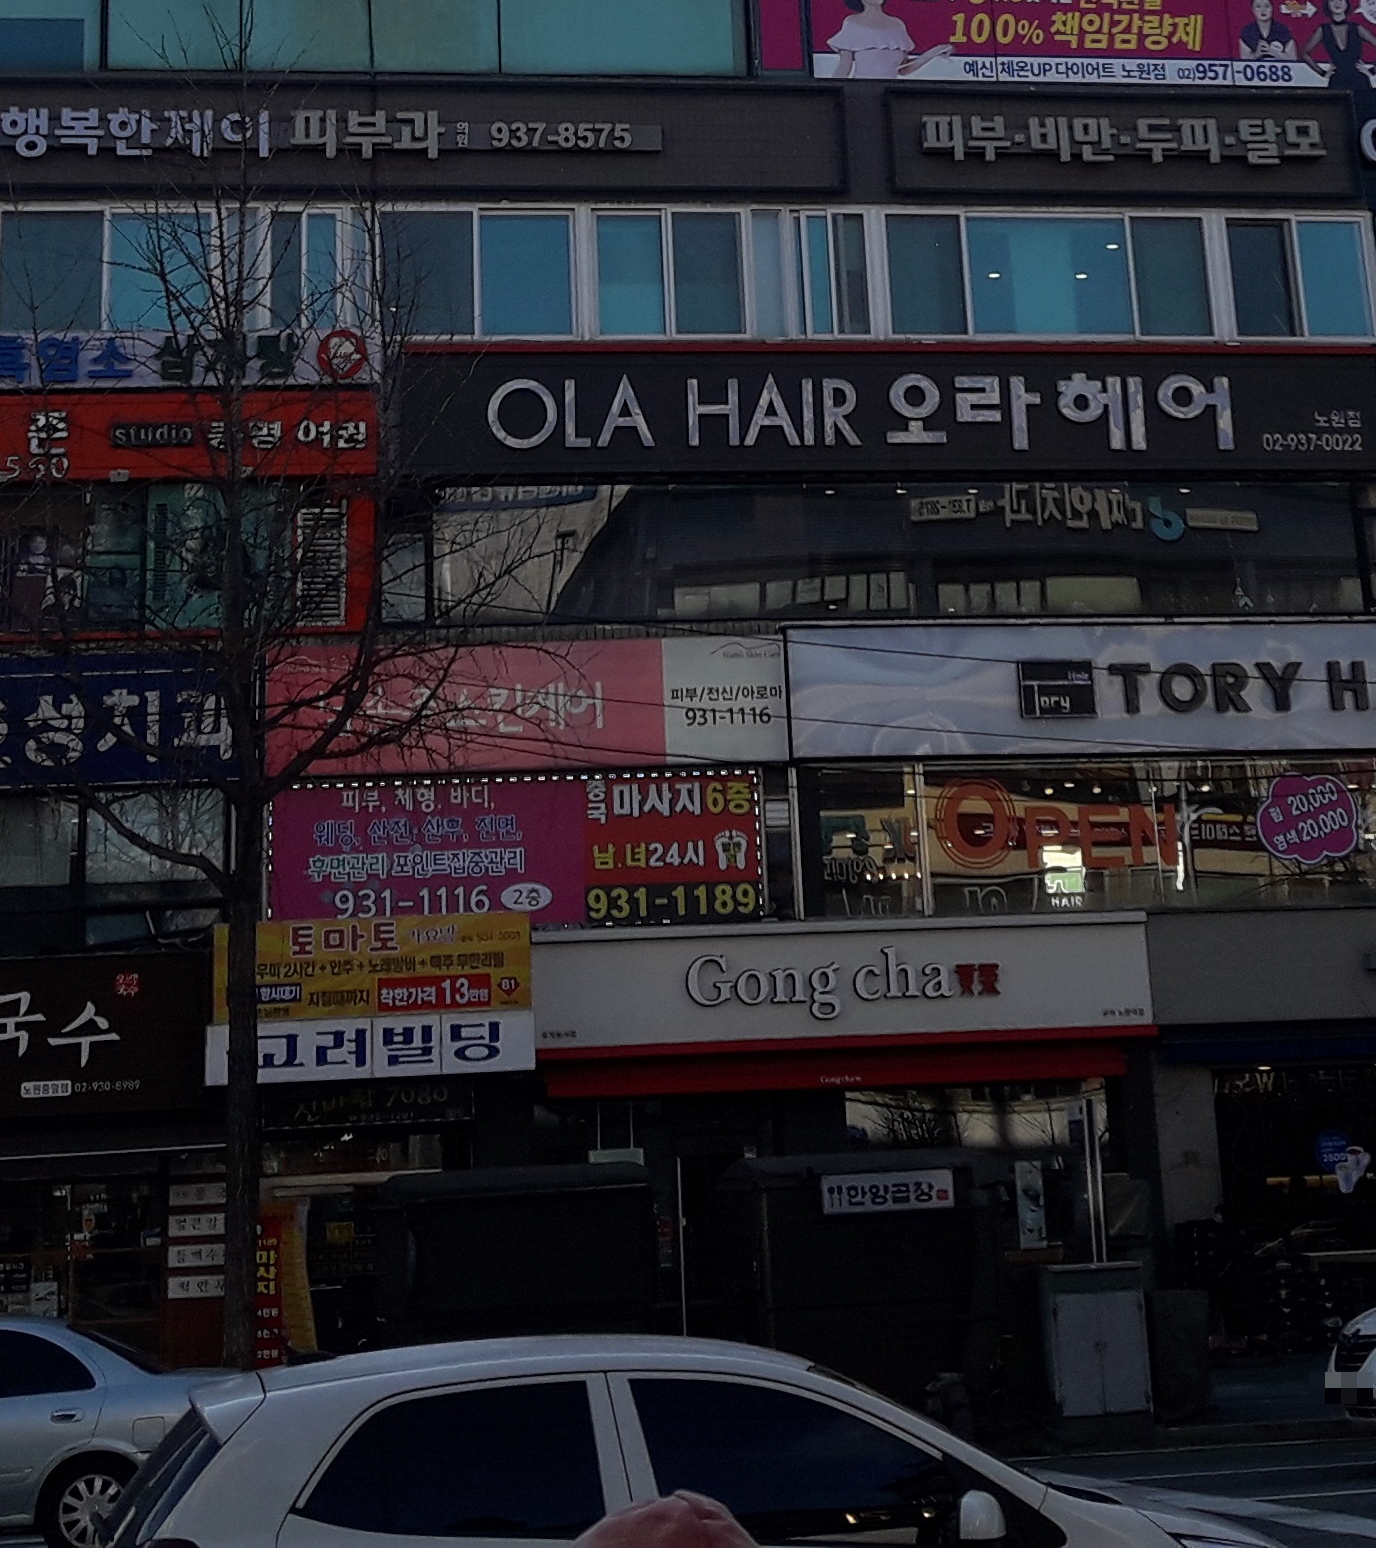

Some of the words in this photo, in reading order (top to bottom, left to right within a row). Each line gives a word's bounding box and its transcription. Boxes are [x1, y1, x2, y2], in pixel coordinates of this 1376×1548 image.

[948, 12, 1046, 48] 100%
[1049, 12, 1205, 53] 책임감량제
[963, 60, 996, 81] 예신
[1055, 60, 1117, 81] 다이어트
[1120, 62, 1168, 83] 노원점
[290, 107, 446, 162] 피부과
[490, 119, 634, 151] 937-8575
[486, 372, 657, 451] OLA
[685, 372, 862, 449] HAIR
[885, 370, 1235, 453] 오라헤어
[1312, 408, 1362, 431] 노원점
[296, 418, 369, 451] 여권
[1261, 431, 1363, 453] 02-937-0022
[1107, 660, 1305, 714] TORY
[684, 706, 773, 728] 931-1116
[611, 781, 703, 817] 마사지
[1286, 781, 1339, 815] 20,000
[935, 777, 1177, 871] OPEN
[1298, 807, 1350, 842] 20,000
[391, 846, 526, 877] 포인트집중관리
[333, 883, 492, 920] 931-1116
[510, 887, 544, 910] 2층
[586, 881, 757, 922] 931-1189
[1050, 895, 1084, 908] HAIR
[288, 920, 401, 958] 토마토
[685, 951, 842, 1020] Gong
[852, 944, 955, 1004] cha
[256, 1018, 503, 1070] 고려빌딩
